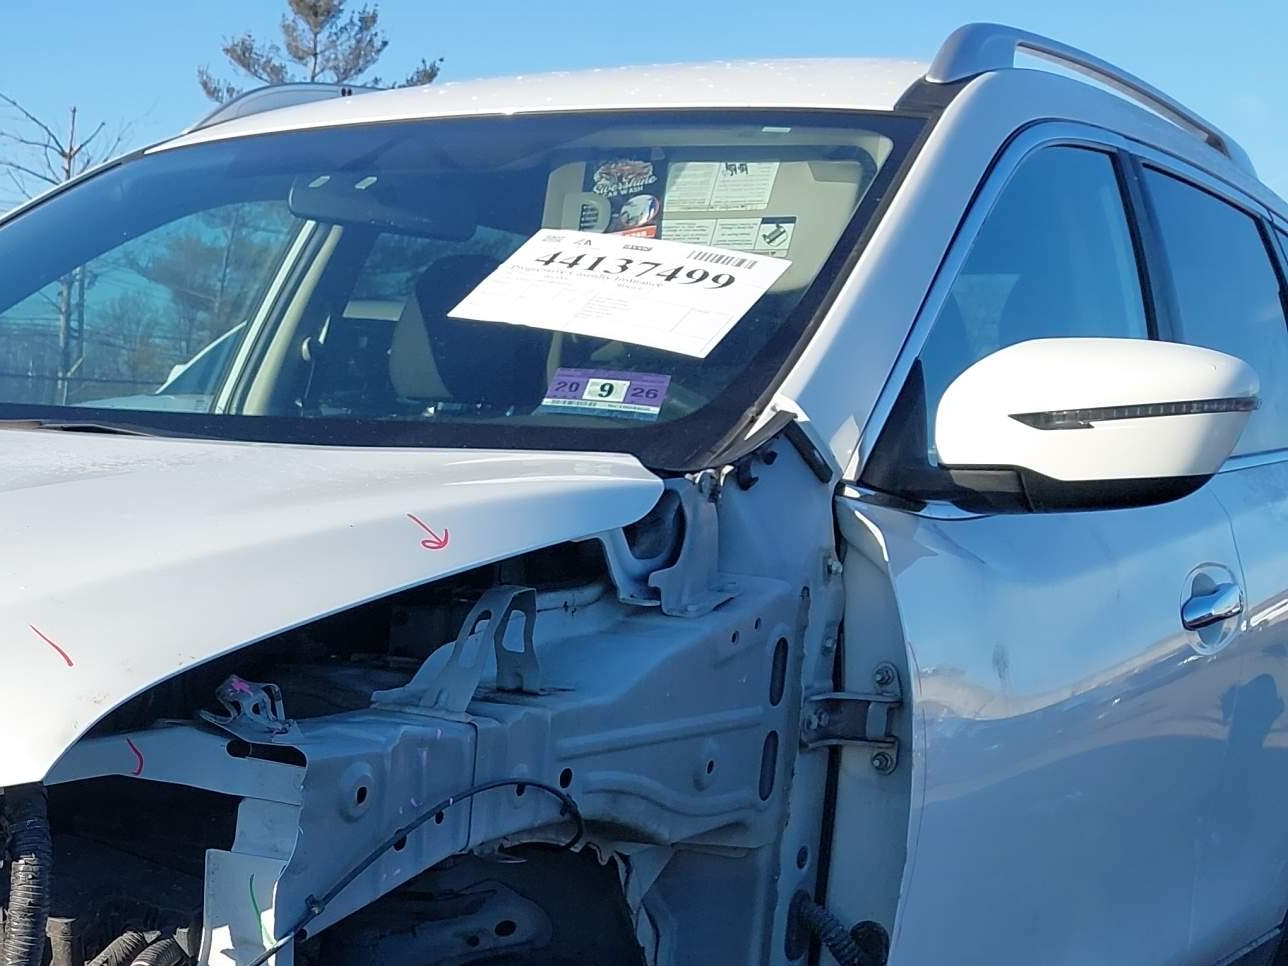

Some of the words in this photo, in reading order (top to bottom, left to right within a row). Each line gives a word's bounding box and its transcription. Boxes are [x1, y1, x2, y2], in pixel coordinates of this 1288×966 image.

[534, 250, 736, 290] 44137499
[554, 381, 581, 393] 20
[598, 382, 615, 399] 9
[630, 387, 660, 400] 26
